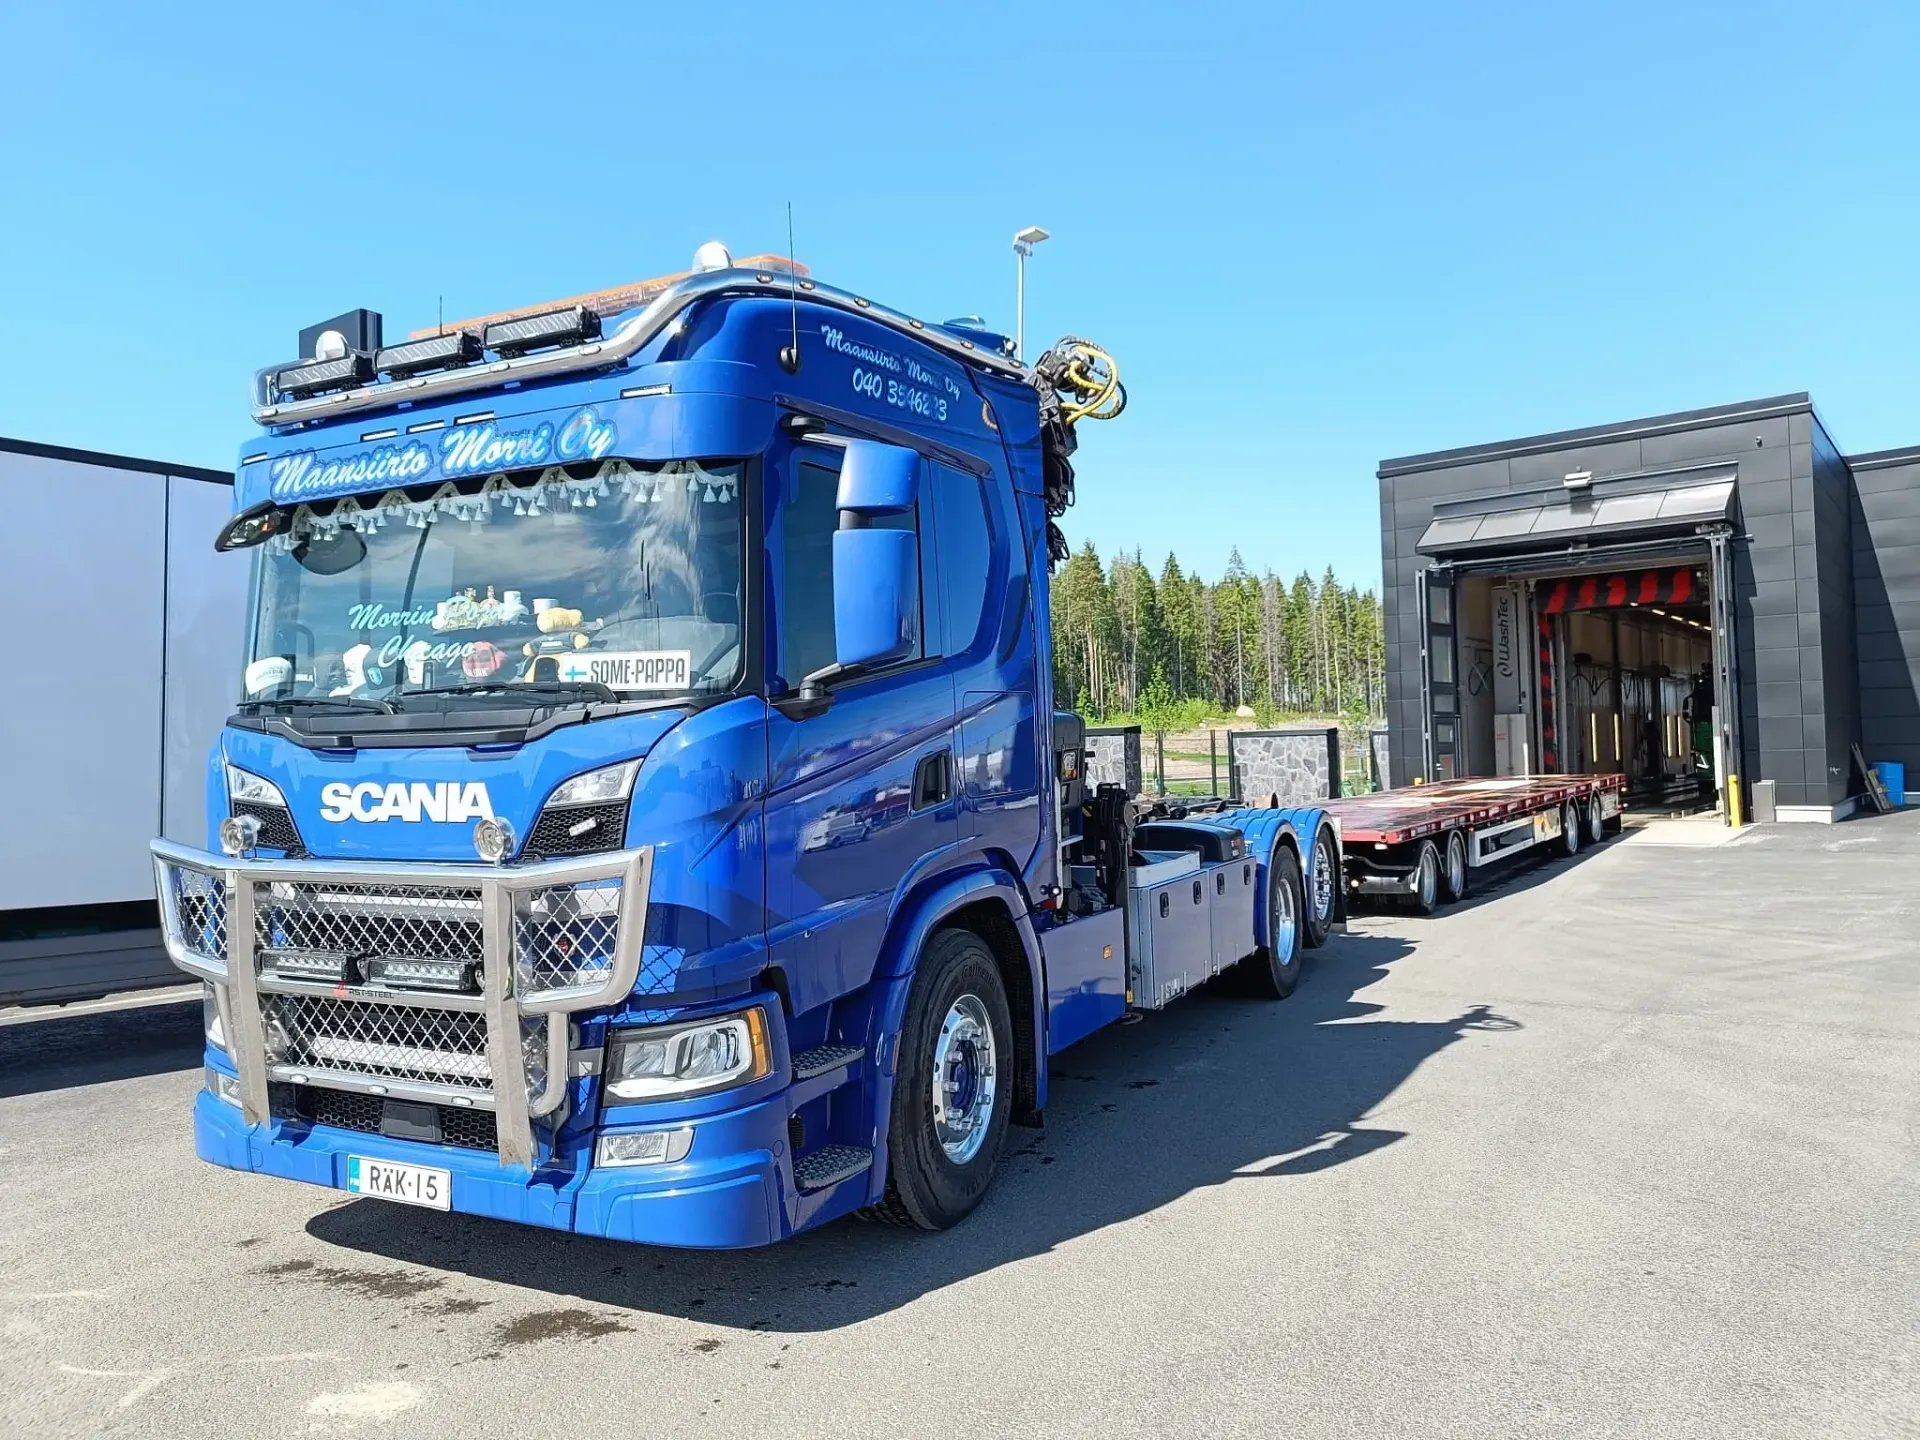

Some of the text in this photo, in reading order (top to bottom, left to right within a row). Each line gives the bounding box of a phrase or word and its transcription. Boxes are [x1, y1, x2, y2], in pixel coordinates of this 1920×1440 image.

[822, 325, 960, 402] Maansiirto Mor Oy
[853, 368, 883, 398] 040
[273, 412, 612, 495] Maansiirto Morri Oy
[349, 604, 435, 630] Morrin
[378, 635, 475, 668] Chcago
[590, 658, 685, 684] SOME-PAPPA
[320, 782, 495, 823] SCANIA
[370, 1165, 438, 1201] RÄK-15
